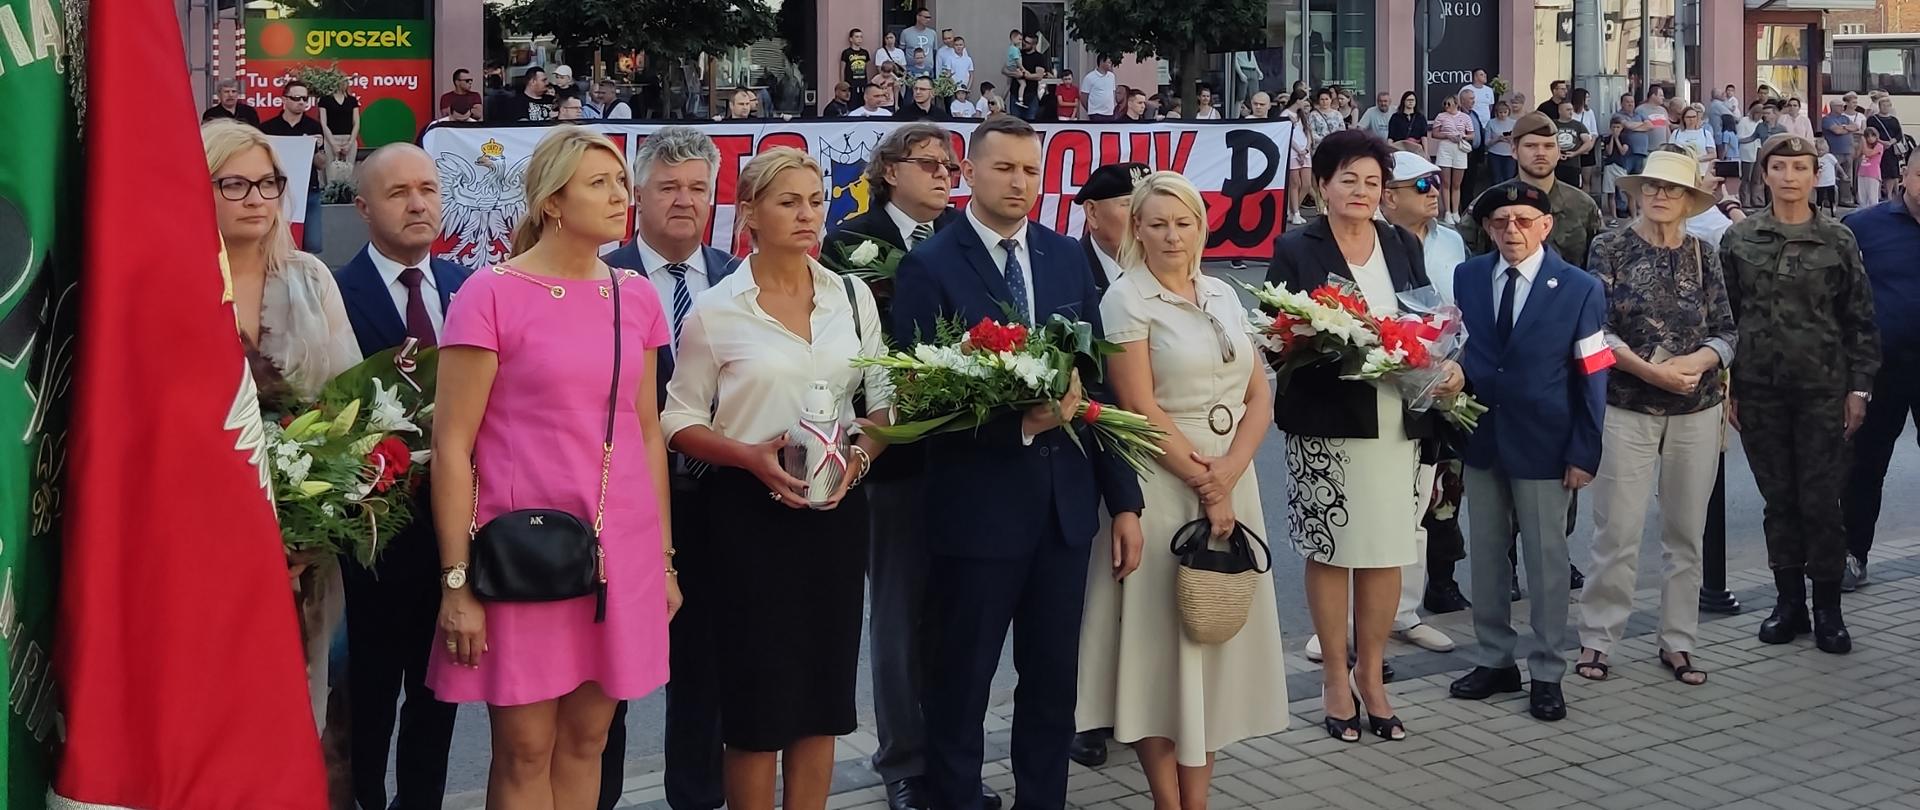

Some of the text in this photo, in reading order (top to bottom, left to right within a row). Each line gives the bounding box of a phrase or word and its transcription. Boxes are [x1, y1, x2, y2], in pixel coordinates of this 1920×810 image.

[1444, 2, 1481, 16] RGIO
[305, 25, 412, 55] groszek
[246, 73, 268, 87] Tu
[373, 75, 418, 90] nowy
[246, 92, 283, 108] skle
[530, 515, 544, 525] MK
